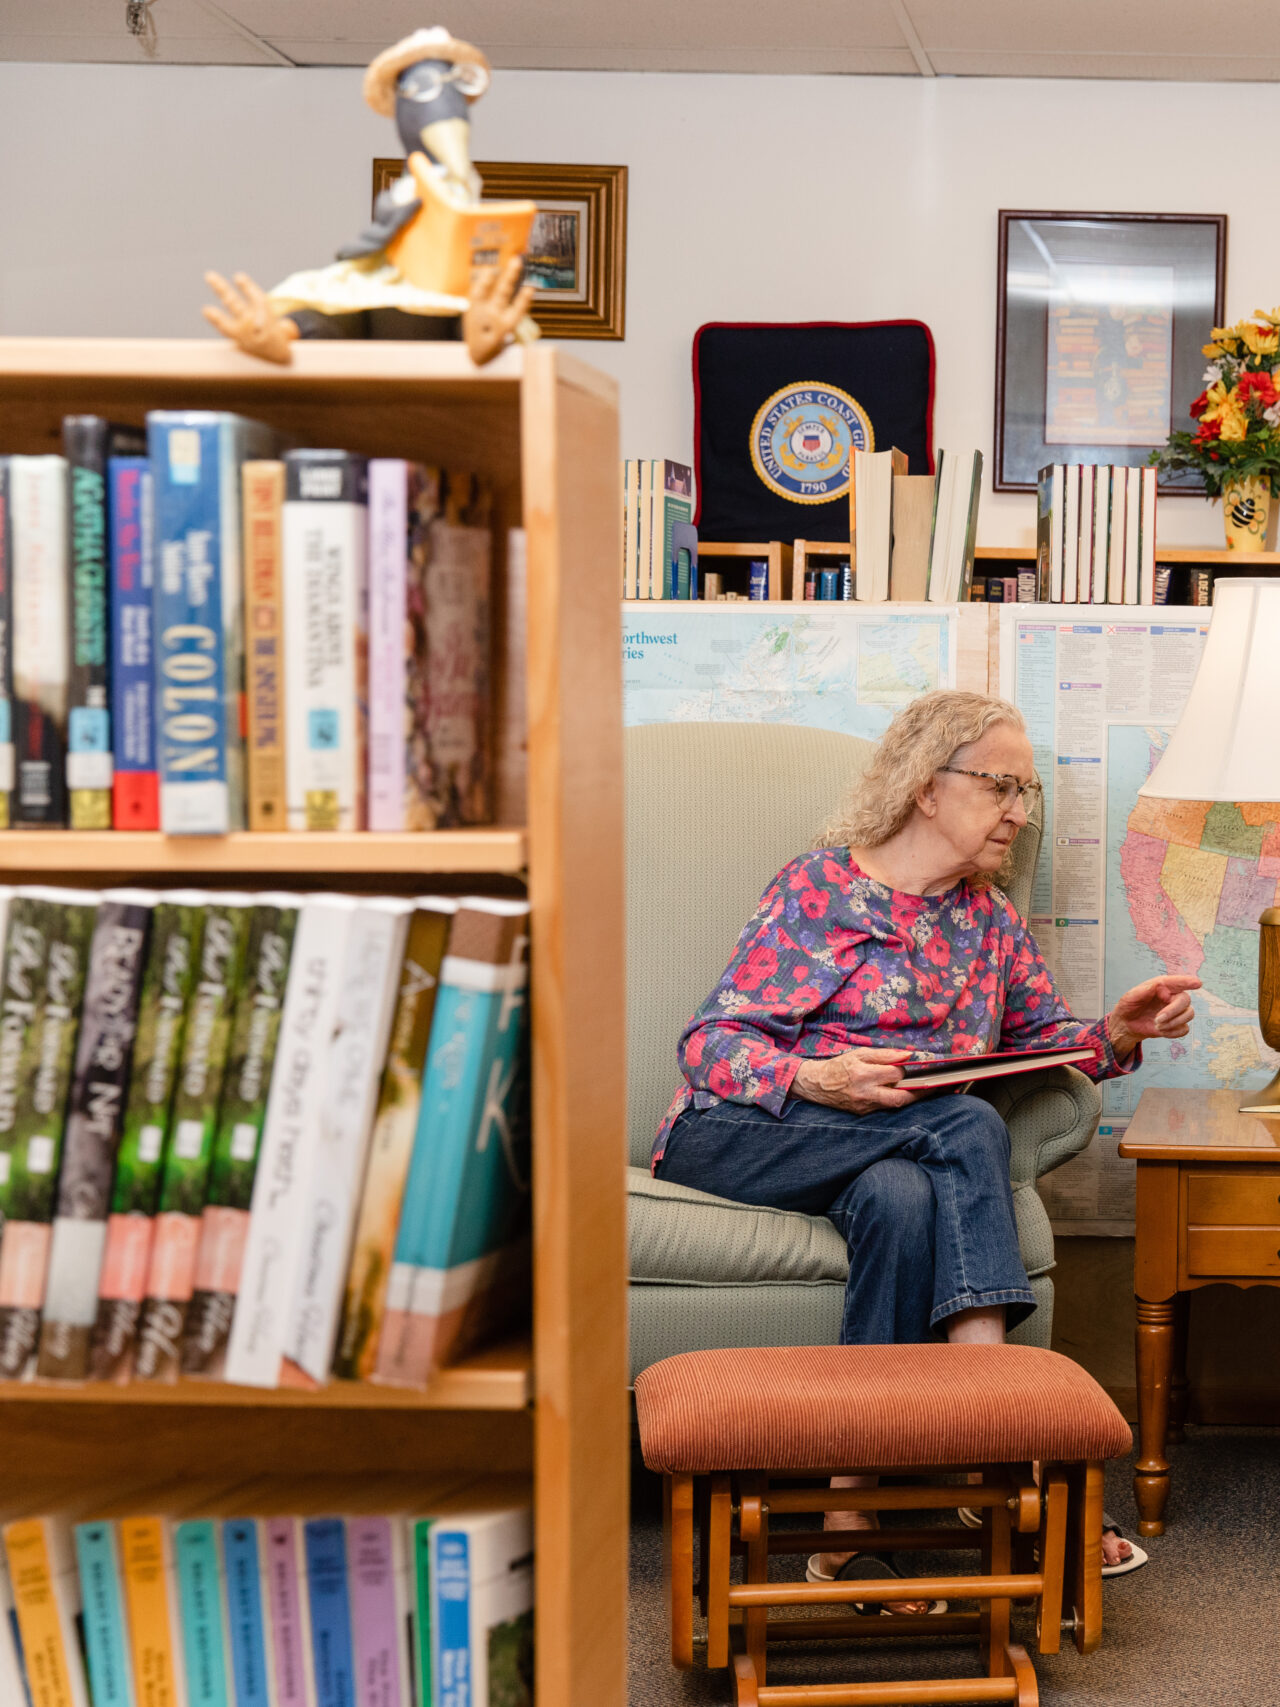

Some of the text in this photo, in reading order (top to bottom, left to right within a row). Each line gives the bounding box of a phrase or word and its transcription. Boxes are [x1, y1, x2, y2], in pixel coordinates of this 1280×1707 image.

[767, 392, 812, 426] STATES
[817, 393, 858, 425] COAST
[760, 427, 782, 479] UNITED
[800, 482, 828, 494] 1790
[73, 467, 106, 667] AGATHA CHRISTIE
[161, 624, 218, 773] COLON
